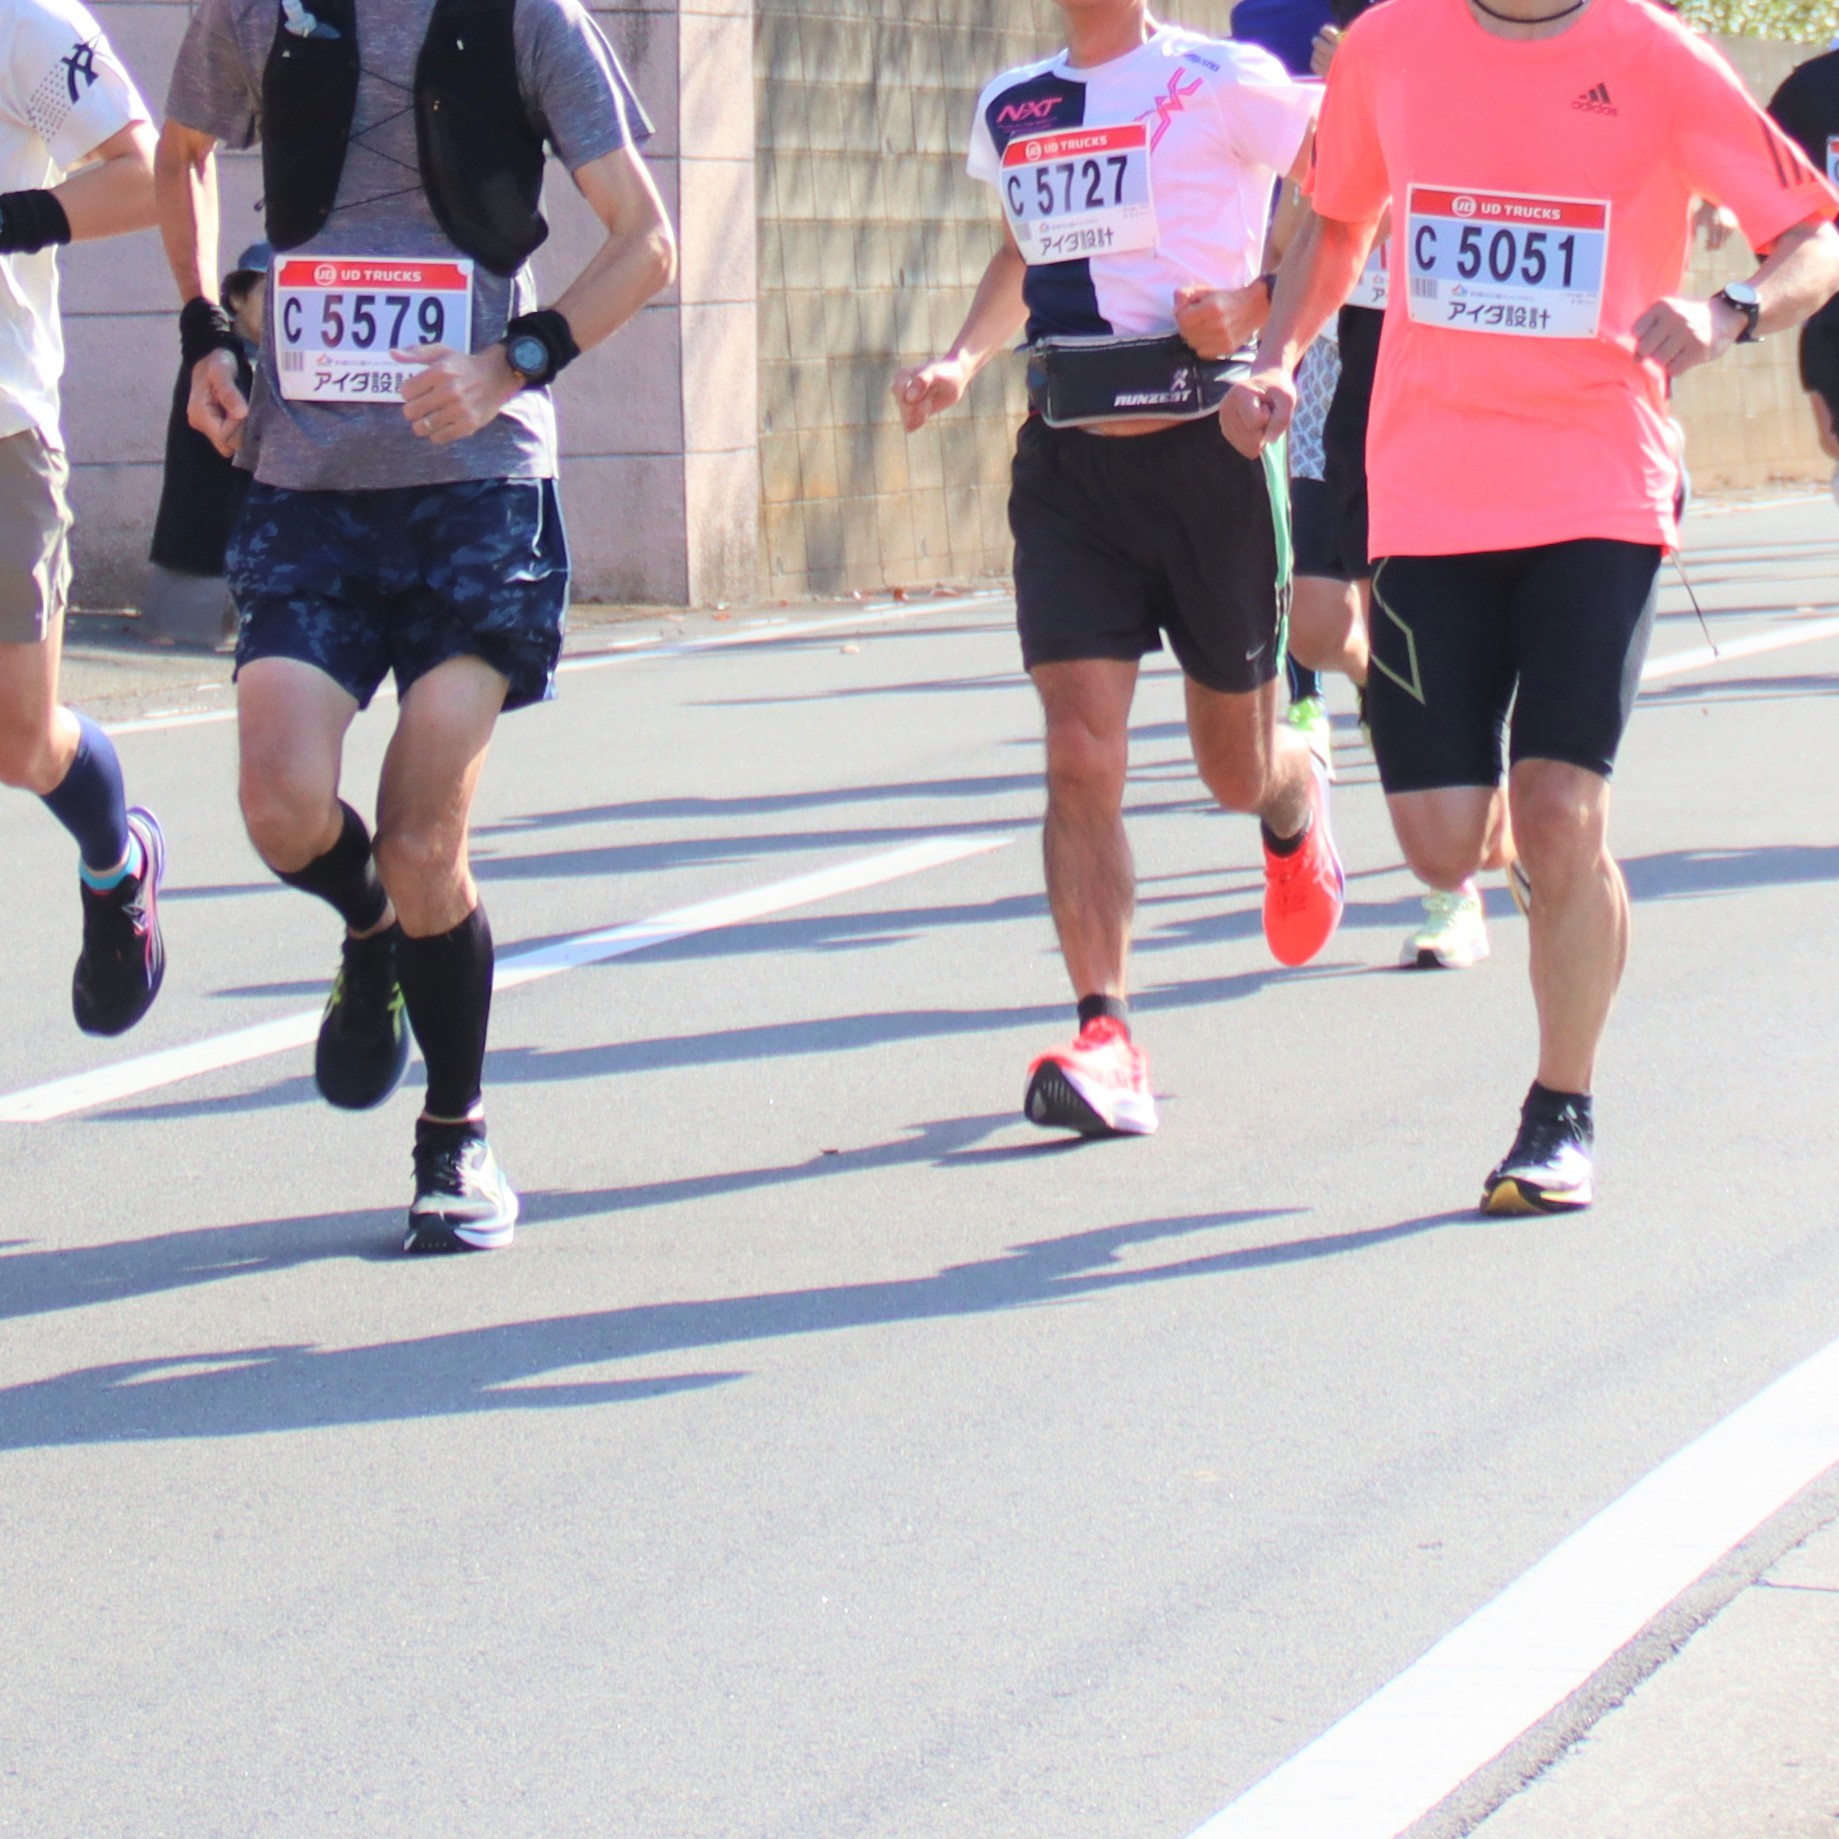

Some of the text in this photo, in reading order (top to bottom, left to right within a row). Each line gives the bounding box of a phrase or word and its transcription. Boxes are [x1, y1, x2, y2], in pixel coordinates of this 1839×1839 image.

[1571, 101, 1618, 117] adidas
[1044, 143, 1059, 155] UD
[1061, 135, 1108, 151] TRUCKS
[1007, 155, 1128, 216] C 5727
[1481, 203, 1500, 215] UD
[1504, 205, 1561, 220] TRUCKS
[1040, 227, 1115, 256] アイダ設計
[1415, 225, 1437, 271] C
[1457, 226, 1575, 288] 5051
[341, 270, 361, 281] UD
[364, 270, 422, 282] TRUCKS
[284, 294, 445, 349] C 5579
[1447, 301, 1551, 329] アイダ設計
